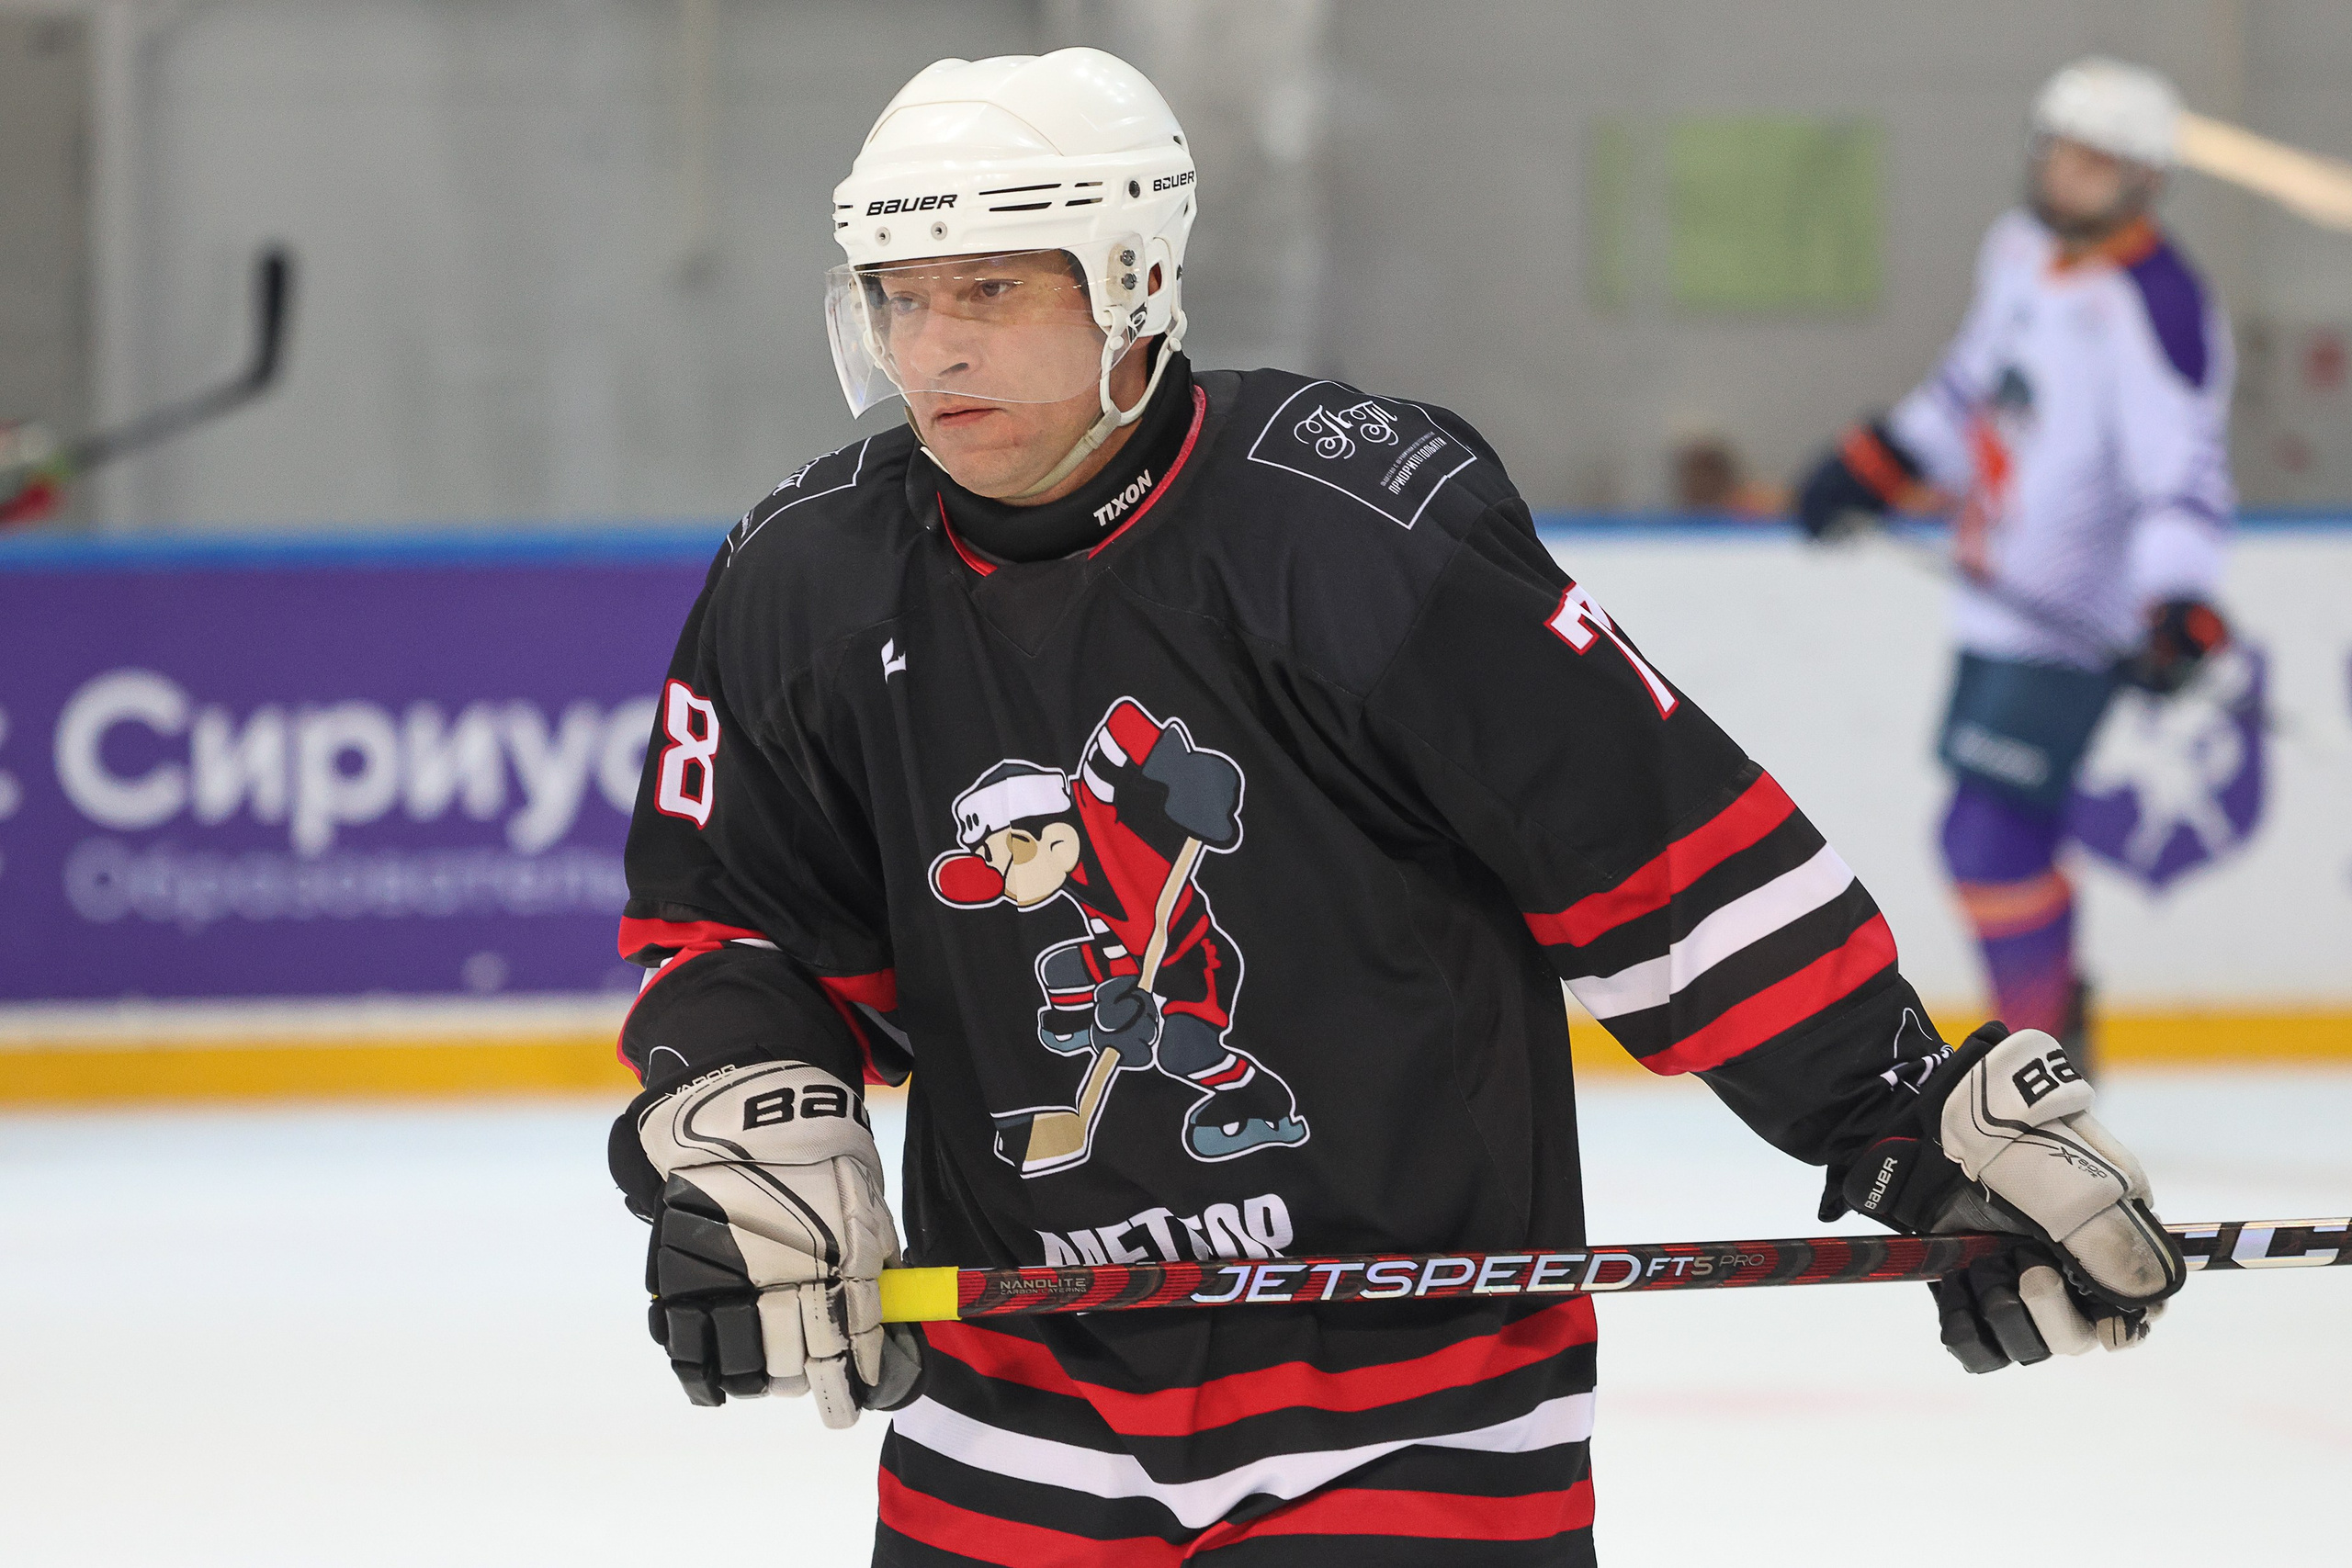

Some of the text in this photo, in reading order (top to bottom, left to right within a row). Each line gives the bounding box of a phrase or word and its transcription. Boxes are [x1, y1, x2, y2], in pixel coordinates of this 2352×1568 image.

[866, 194, 957, 216] BAUER
[1153, 171, 1194, 191] BAUER
[1093, 468, 1153, 526] TIXON
[653, 677, 722, 830] 8
[1864, 1156, 1898, 1210] BAUER
[1000, 1278, 1086, 1290] NANOLITE
[1190, 1253, 1642, 1303] JETSPEED
[1718, 1254, 1765, 1268] PRO
